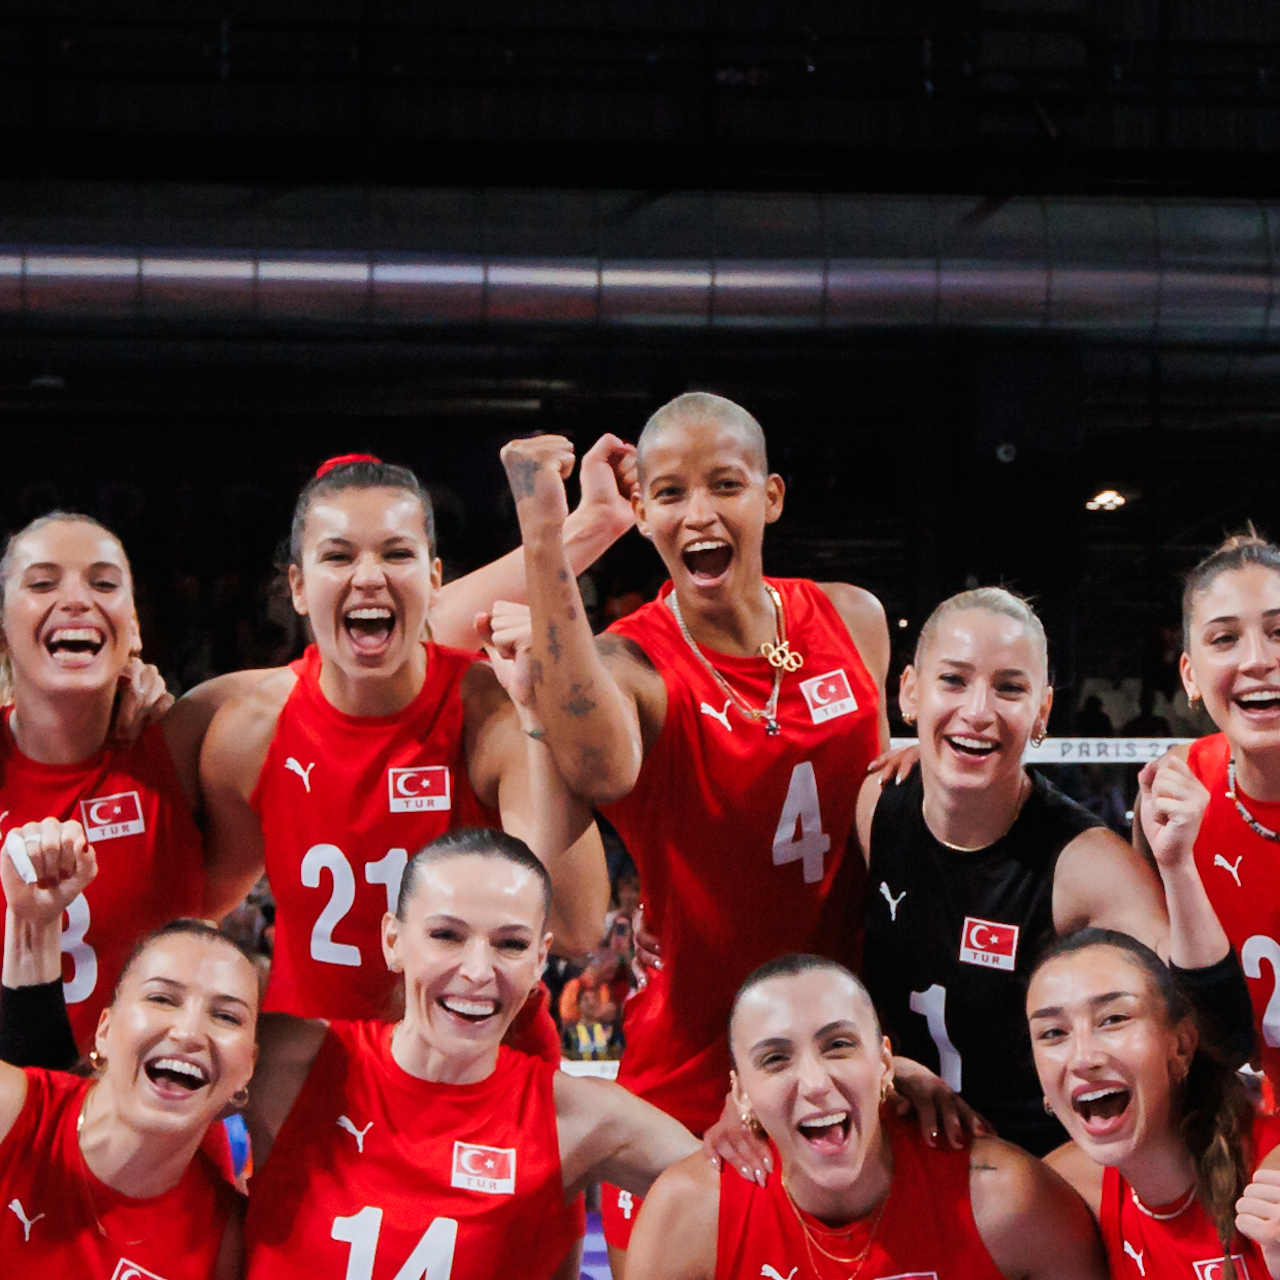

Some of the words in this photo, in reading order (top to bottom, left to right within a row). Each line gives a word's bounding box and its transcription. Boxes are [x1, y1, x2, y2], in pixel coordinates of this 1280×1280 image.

[1061, 742, 1137, 758] PARIS
[403, 799, 435, 809] TUR
[772, 761, 830, 883] 4
[100, 825, 130, 837] TUR
[301, 843, 408, 966] 21
[970, 951, 1001, 964] TUR
[909, 983, 962, 1093] 1
[467, 1178, 497, 1191] TUR
